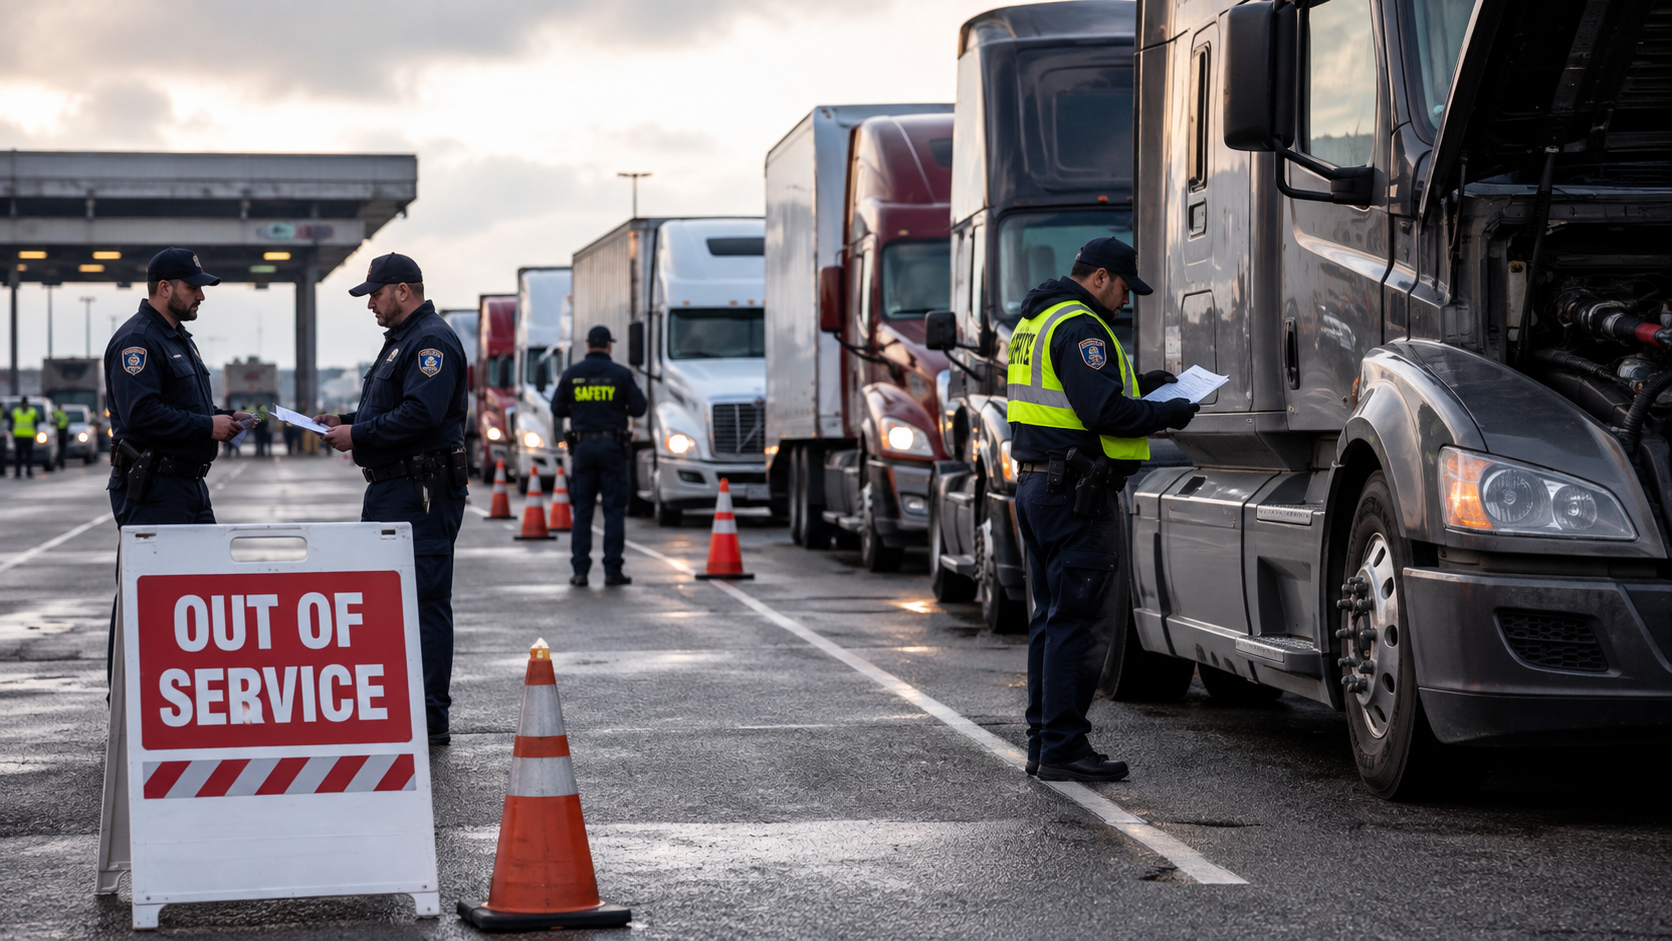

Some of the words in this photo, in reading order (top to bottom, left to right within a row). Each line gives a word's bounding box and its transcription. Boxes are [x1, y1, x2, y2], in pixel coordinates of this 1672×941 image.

[574, 385, 616, 402] SAFETY
[173, 593, 279, 652] OUT
[296, 591, 364, 650] OF
[158, 663, 388, 728] SERVICE
